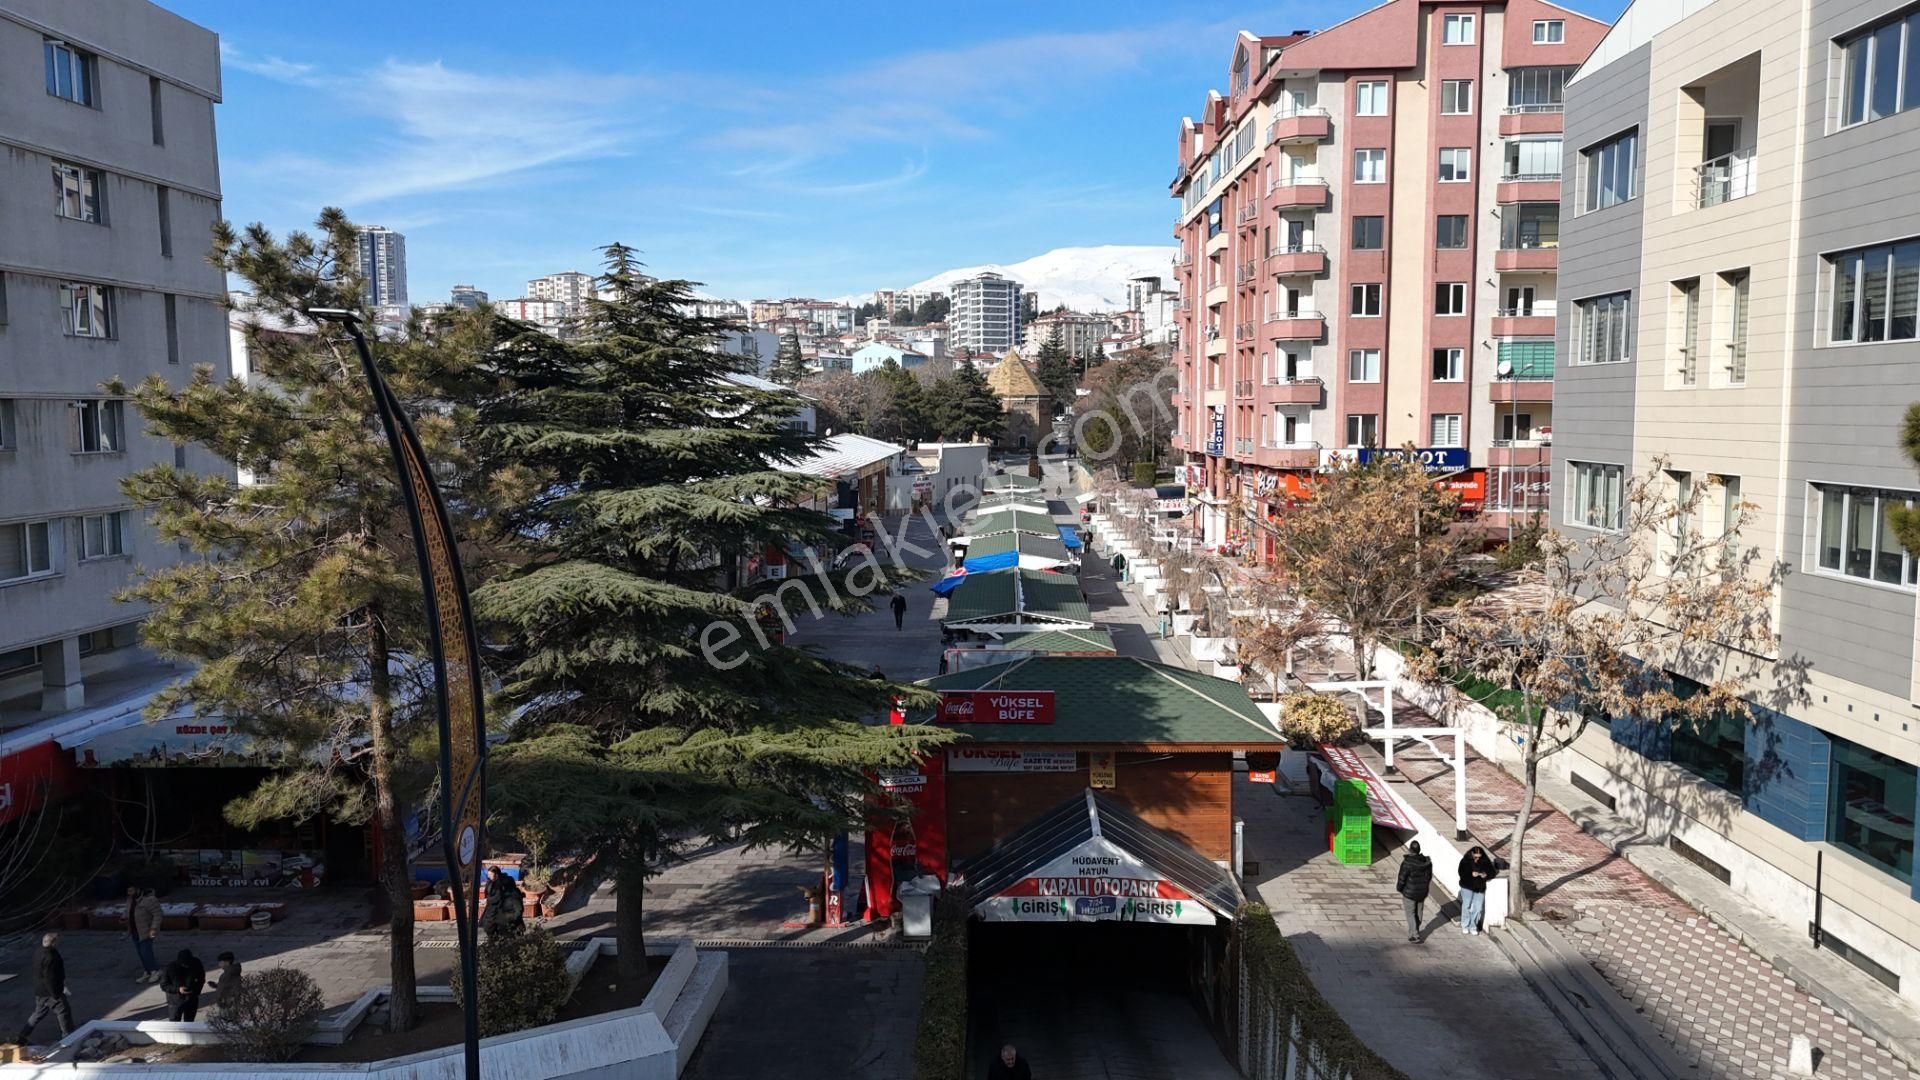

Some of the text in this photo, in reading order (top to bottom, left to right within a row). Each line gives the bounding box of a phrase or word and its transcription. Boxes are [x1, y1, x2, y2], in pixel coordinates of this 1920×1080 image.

[1215, 414, 1224, 450] METOT
[990, 696, 1043, 708] YÜKSEL
[999, 708, 1035, 720] BÜFE
[1072, 856, 1120, 866] HÜDAVENT
[1079, 866, 1109, 876] HATUN
[1038, 878, 1160, 898] KAPALI OTOPARK
[1021, 899, 1059, 915] GİRİŞ
[1081, 905, 1110, 915] HİZMET
[1138, 902, 1173, 917] GİRİŞ
